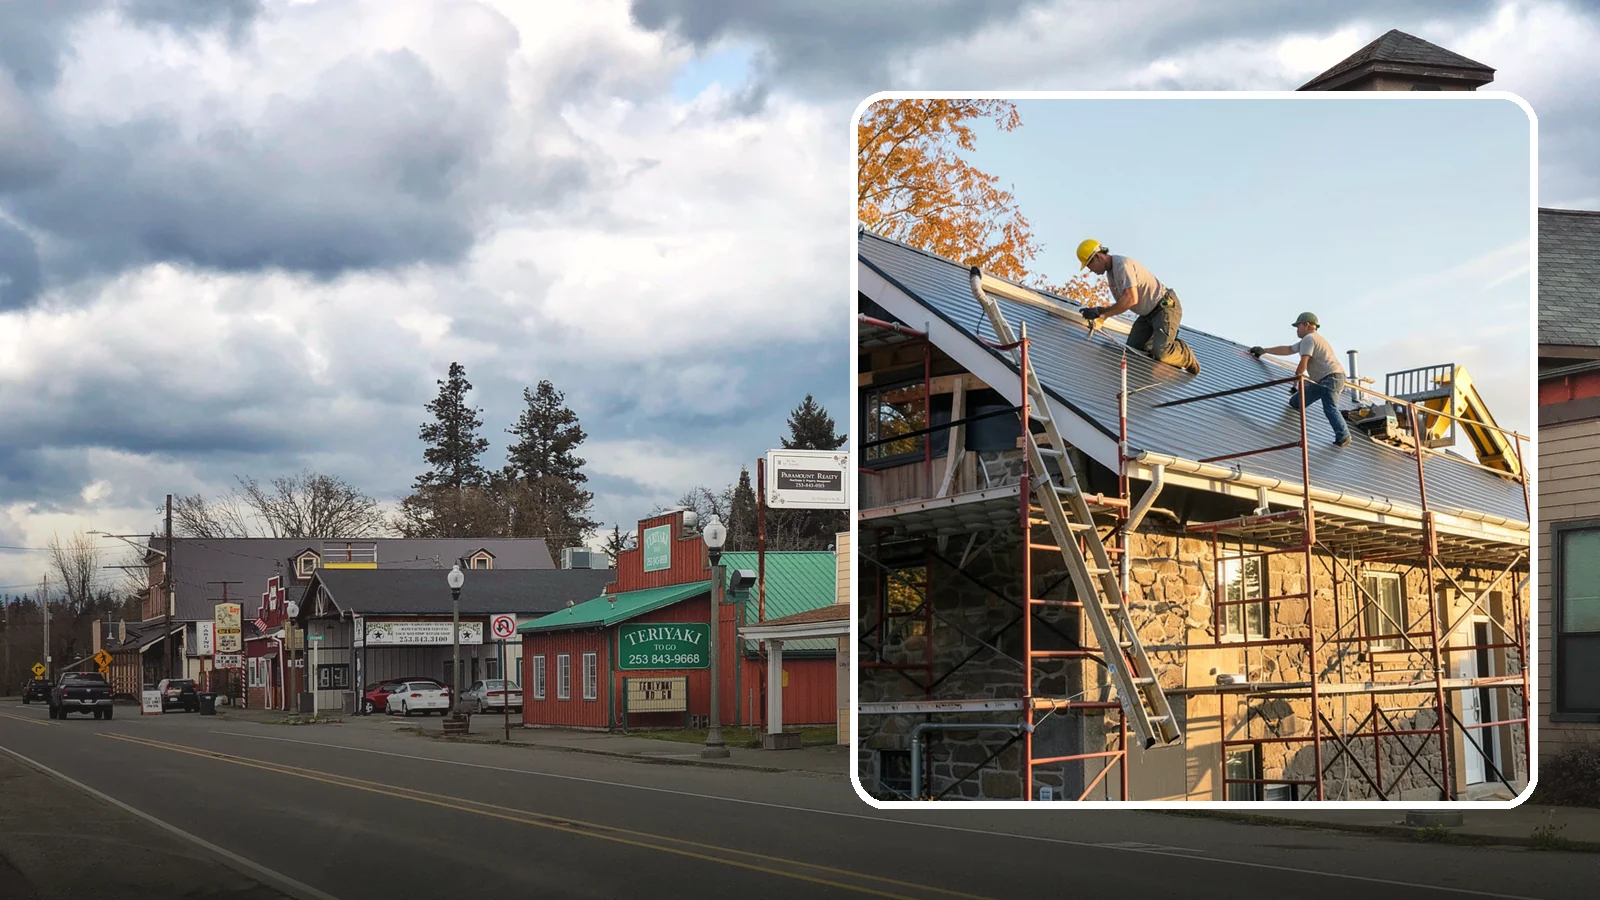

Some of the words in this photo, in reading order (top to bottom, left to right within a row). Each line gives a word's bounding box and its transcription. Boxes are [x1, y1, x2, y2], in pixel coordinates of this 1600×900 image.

[817, 472, 838, 480] REALTY
[624, 627, 702, 646] TERIYAKI
[629, 654, 648, 664] 253
[651, 653, 700, 664] 843-9668
[640, 681, 672, 691] TERIYAKI
